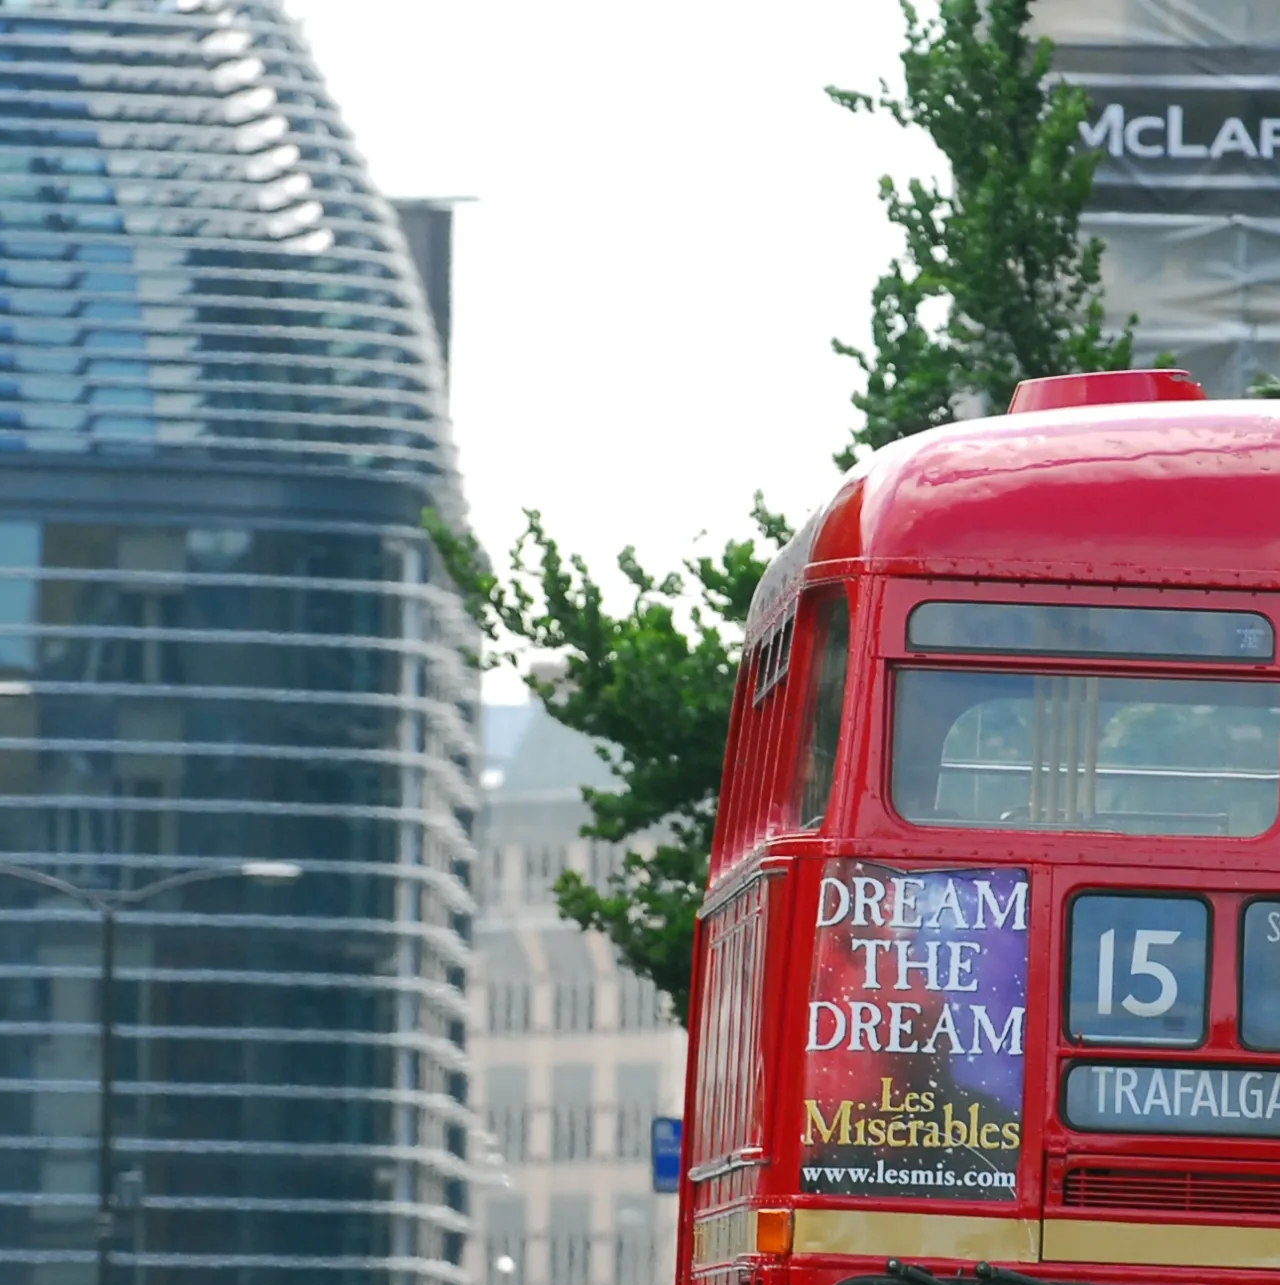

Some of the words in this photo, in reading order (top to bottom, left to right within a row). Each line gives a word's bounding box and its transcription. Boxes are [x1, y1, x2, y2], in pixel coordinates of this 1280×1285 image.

[816, 877, 1029, 931] DREAM
[851, 939, 980, 992] THE
[1097, 928, 1182, 1017] 15
[805, 1001, 1026, 1055] DREAM
[879, 1077, 935, 1113] Les
[801, 1099, 1020, 1150] Misérables
[802, 1160, 1016, 1188] www.lesmis.com
